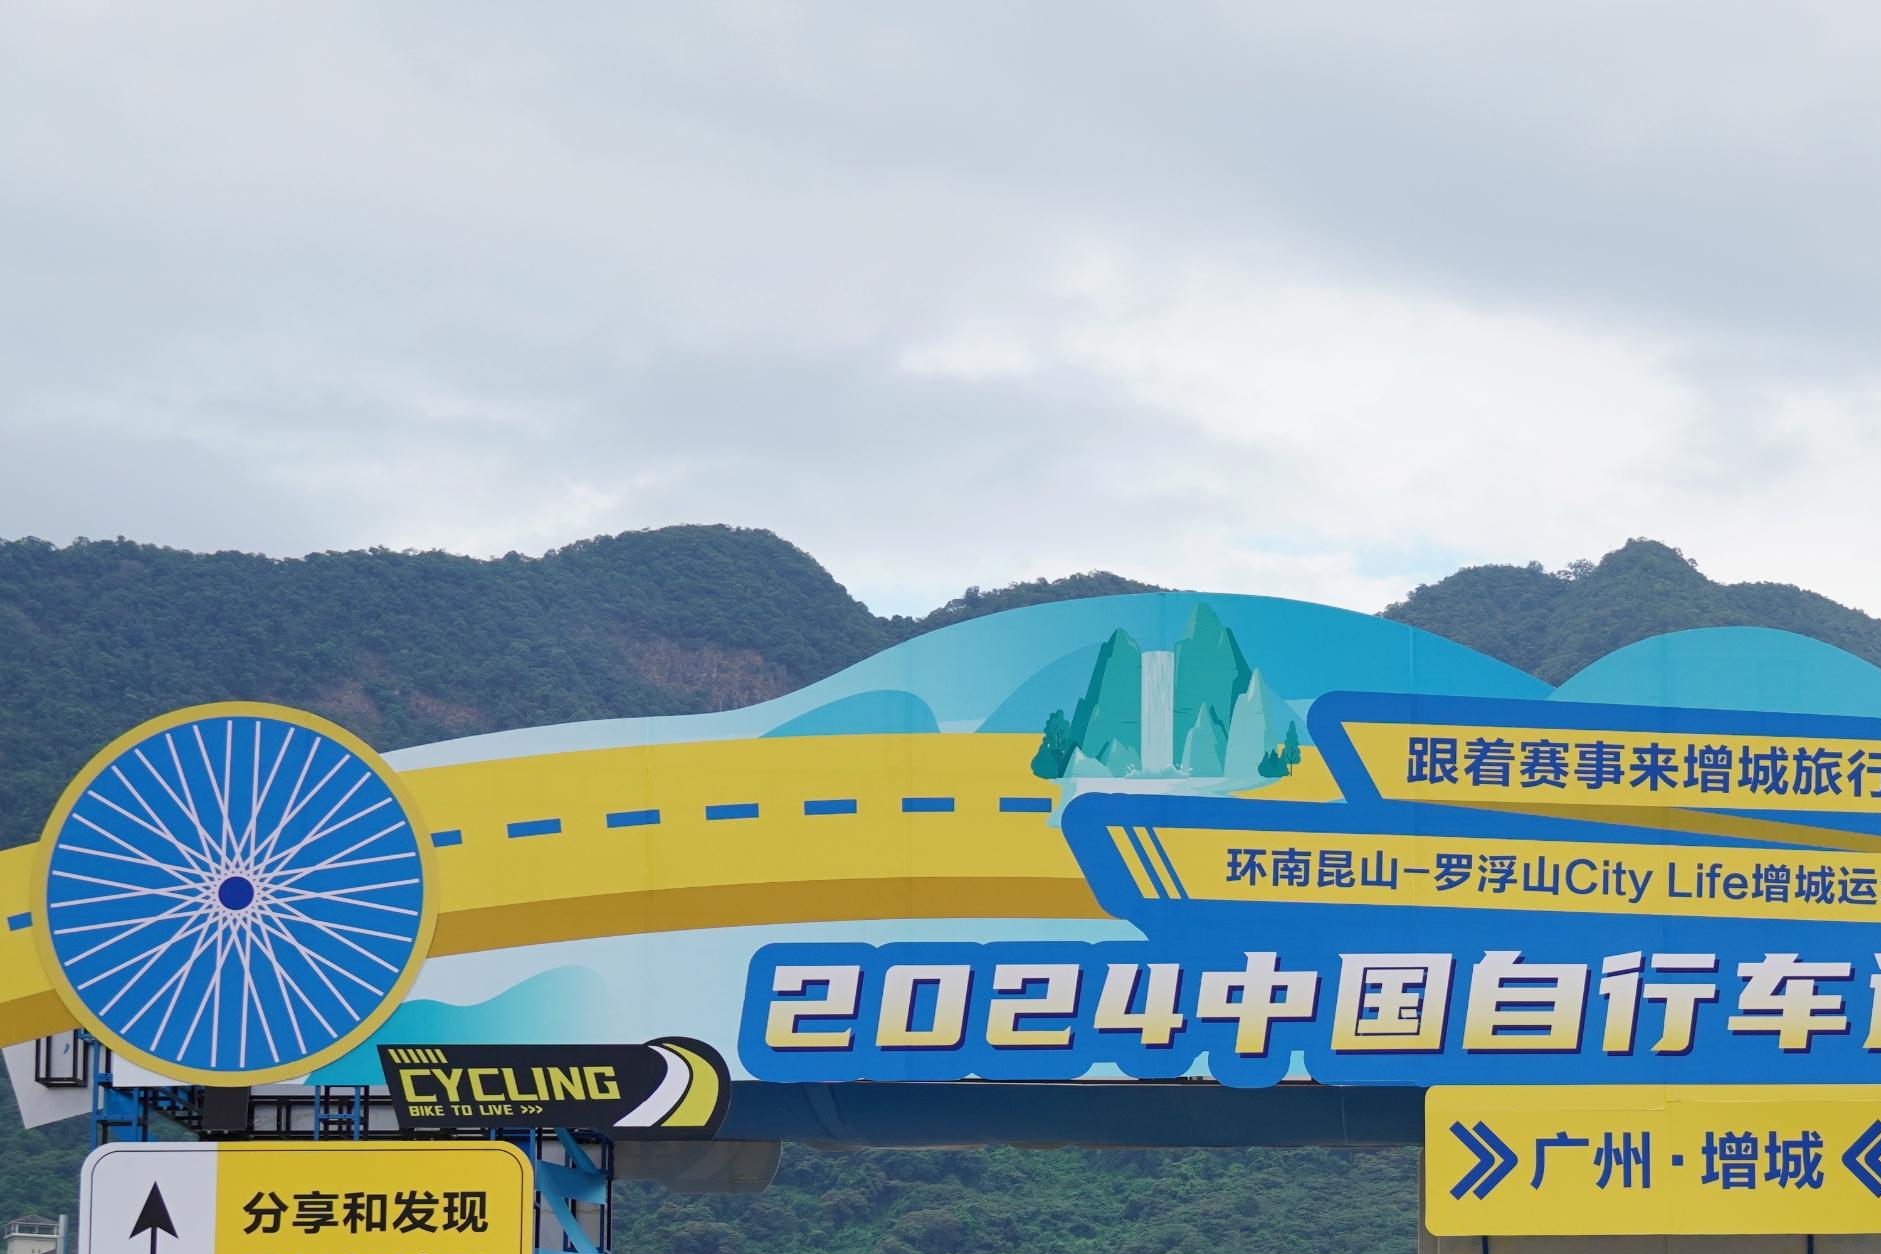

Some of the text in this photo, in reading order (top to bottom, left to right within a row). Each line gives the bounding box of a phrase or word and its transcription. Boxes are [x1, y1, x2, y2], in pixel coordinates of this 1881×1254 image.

[399, 1064, 621, 1102] CYCLING
[409, 1104, 515, 1118] BIKE TO LIVE
[1529, 1130, 1826, 1191] 广州·增城
[241, 1190, 489, 1235] 分享和发现
